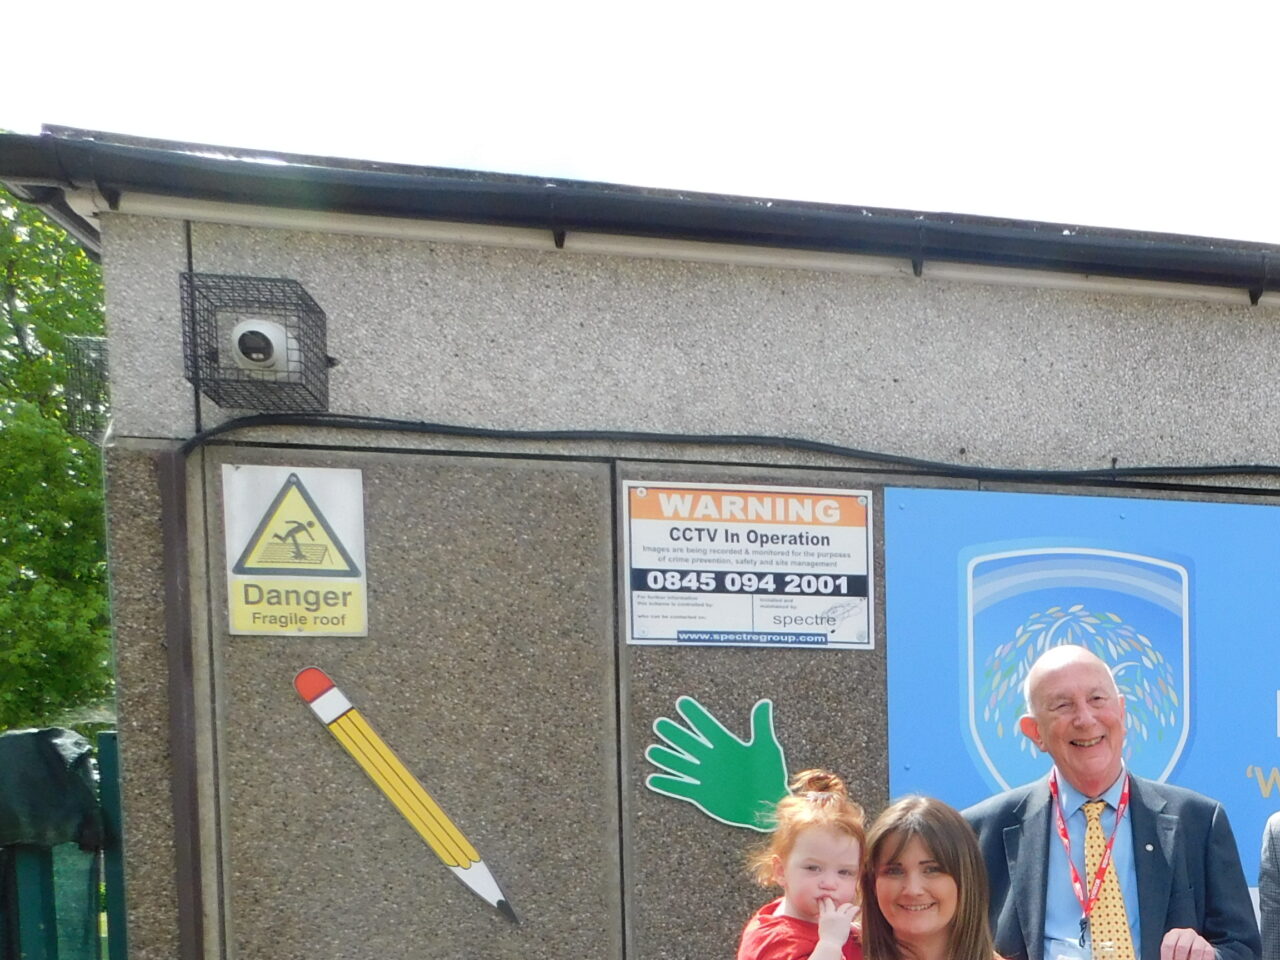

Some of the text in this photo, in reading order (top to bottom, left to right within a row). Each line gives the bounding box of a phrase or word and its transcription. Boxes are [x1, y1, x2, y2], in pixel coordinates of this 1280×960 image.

[658, 493, 841, 523] WARNING
[669, 527, 831, 548] CCTV In Operation
[642, 545, 670, 554] Images
[686, 546, 708, 555] being
[709, 547, 743, 555] recorded
[752, 549, 790, 557] monitored
[791, 549, 801, 557] for
[658, 555, 666, 563] of
[735, 557, 757, 566] safety
[790, 560, 838, 568] management
[646, 570, 848, 594] 0845 094 2001
[243, 583, 352, 612] Danger
[252, 612, 347, 628] Fragile roof
[773, 614, 837, 628] spectre
[678, 632, 826, 643] www.spectregroup.com
